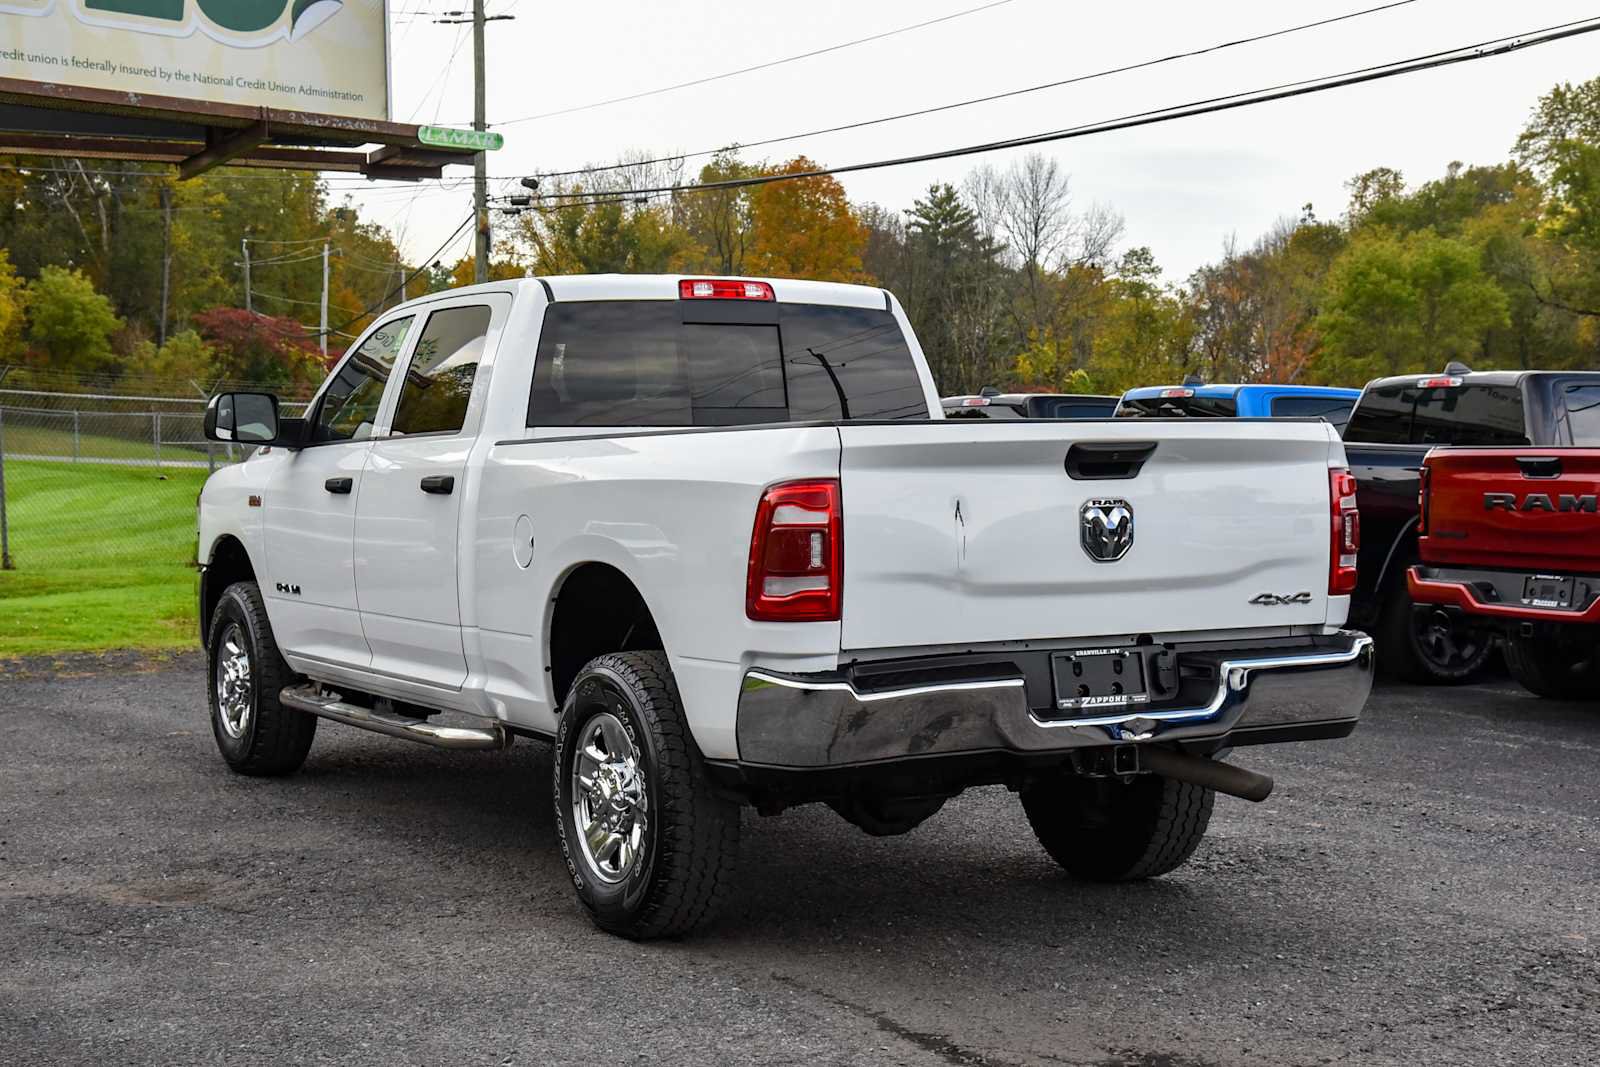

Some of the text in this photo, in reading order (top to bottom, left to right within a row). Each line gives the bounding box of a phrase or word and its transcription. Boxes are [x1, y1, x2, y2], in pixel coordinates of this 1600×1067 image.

[28, 53, 58, 65] union
[61, 56, 69, 67] is
[72, 56, 117, 75] federally
[120, 63, 157, 78] insured
[159, 67, 171, 82] by
[174, 70, 191, 82] the
[193, 72, 234, 87] National
[236, 77, 265, 90] Credit
[268, 81, 296, 94] Union
[299, 84, 363, 102] Administration
[425, 128, 496, 146] LAMAR
[1483, 492, 1598, 512] RAM
[1081, 696, 1127, 707] ZAPPONE
